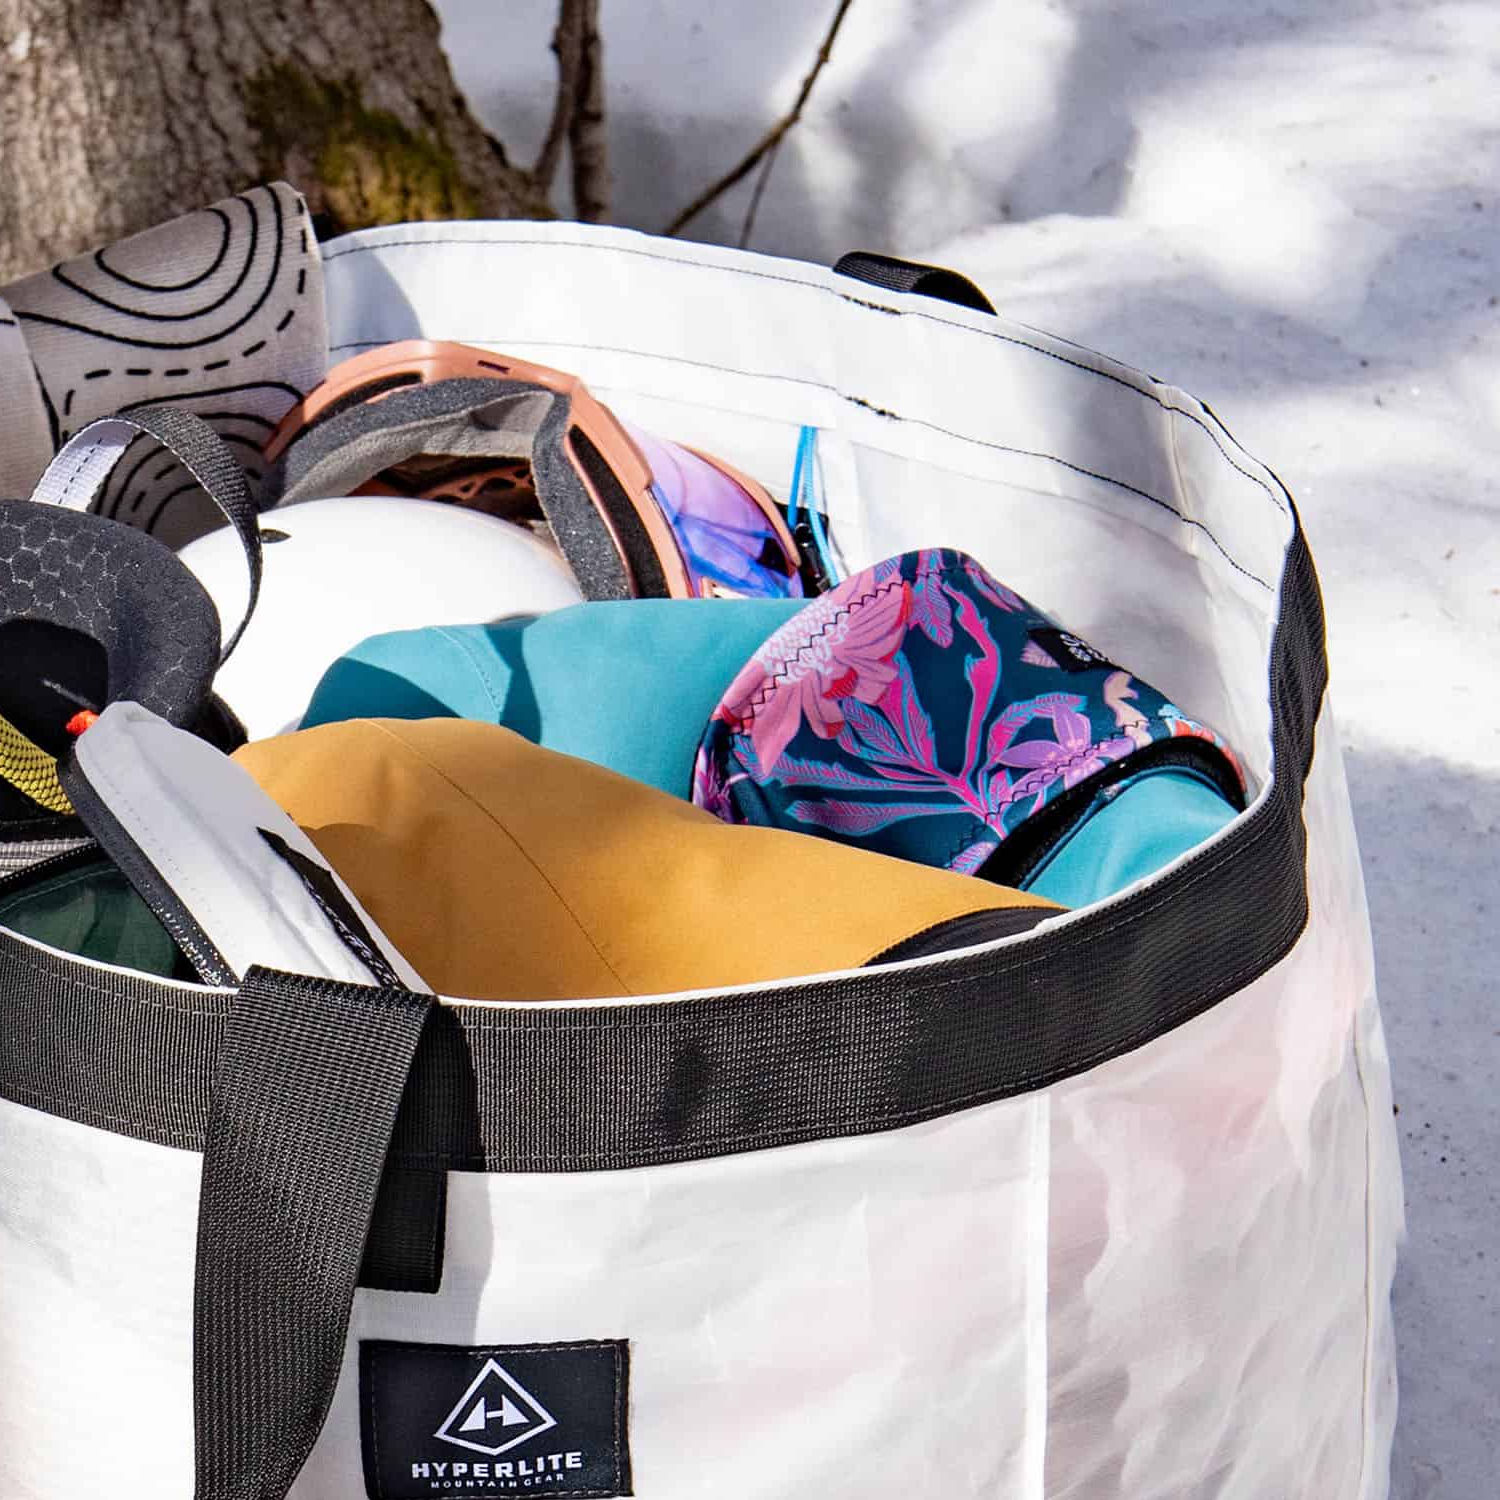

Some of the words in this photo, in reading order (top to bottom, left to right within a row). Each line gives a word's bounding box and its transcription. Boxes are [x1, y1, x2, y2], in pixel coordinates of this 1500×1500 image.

[411, 1451, 583, 1479] HYPERLITE
[430, 1479, 518, 1489] MOUNTAIN
[523, 1472, 565, 1487] GEAR
